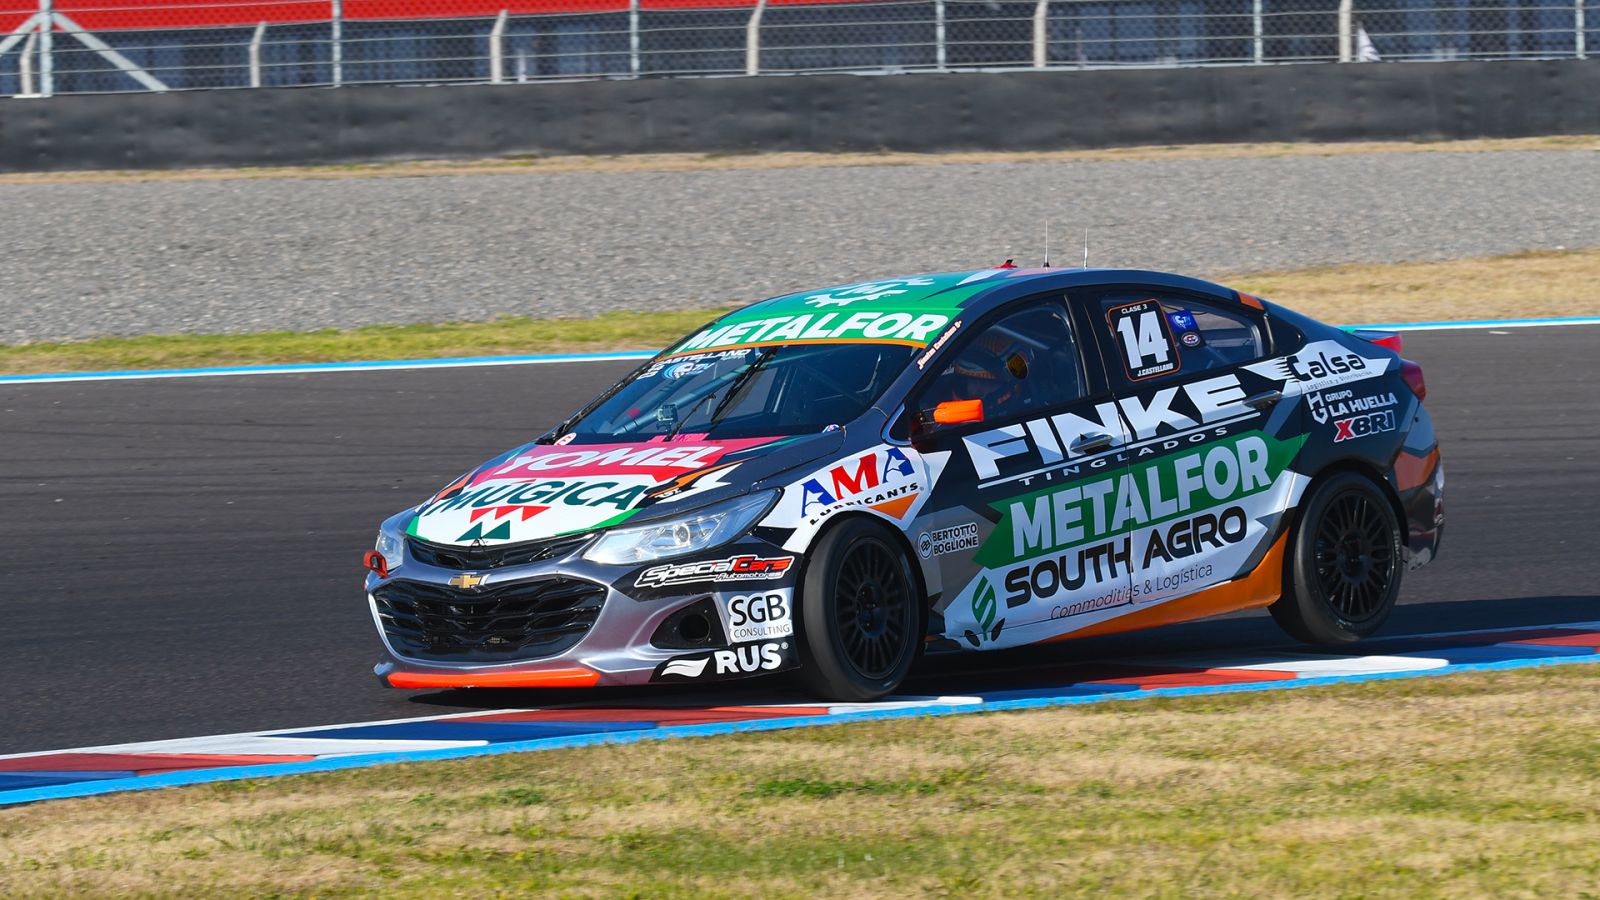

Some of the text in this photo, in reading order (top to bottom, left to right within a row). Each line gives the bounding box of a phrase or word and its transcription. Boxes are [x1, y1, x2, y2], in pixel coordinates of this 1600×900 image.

[1121, 304, 1141, 315] CLASE
[672, 312, 948, 354] METALFOR
[1117, 311, 1169, 369] 14
[1285, 351, 1366, 382] Calsa
[1325, 389, 1353, 402] GRUPO
[1328, 393, 1398, 417] LA HUELLA
[961, 373, 1257, 480] FINKE
[1334, 409, 1396, 443] XBRI
[492, 446, 725, 476] YOMEL
[1018, 427, 1228, 486] TINGLADOS
[801, 447, 915, 518] AMA
[1010, 436, 1272, 557] METALFOR
[809, 482, 919, 526] LUBRICANTS
[932, 523, 977, 542] BERTOTTO
[933, 536, 978, 555] BOGLIONE
[1005, 505, 1248, 608] SOUTH AGRO
[1051, 563, 1214, 619] Commodities & Logística
[731, 594, 786, 627] SGB
[733, 624, 791, 639] CONSULTING
